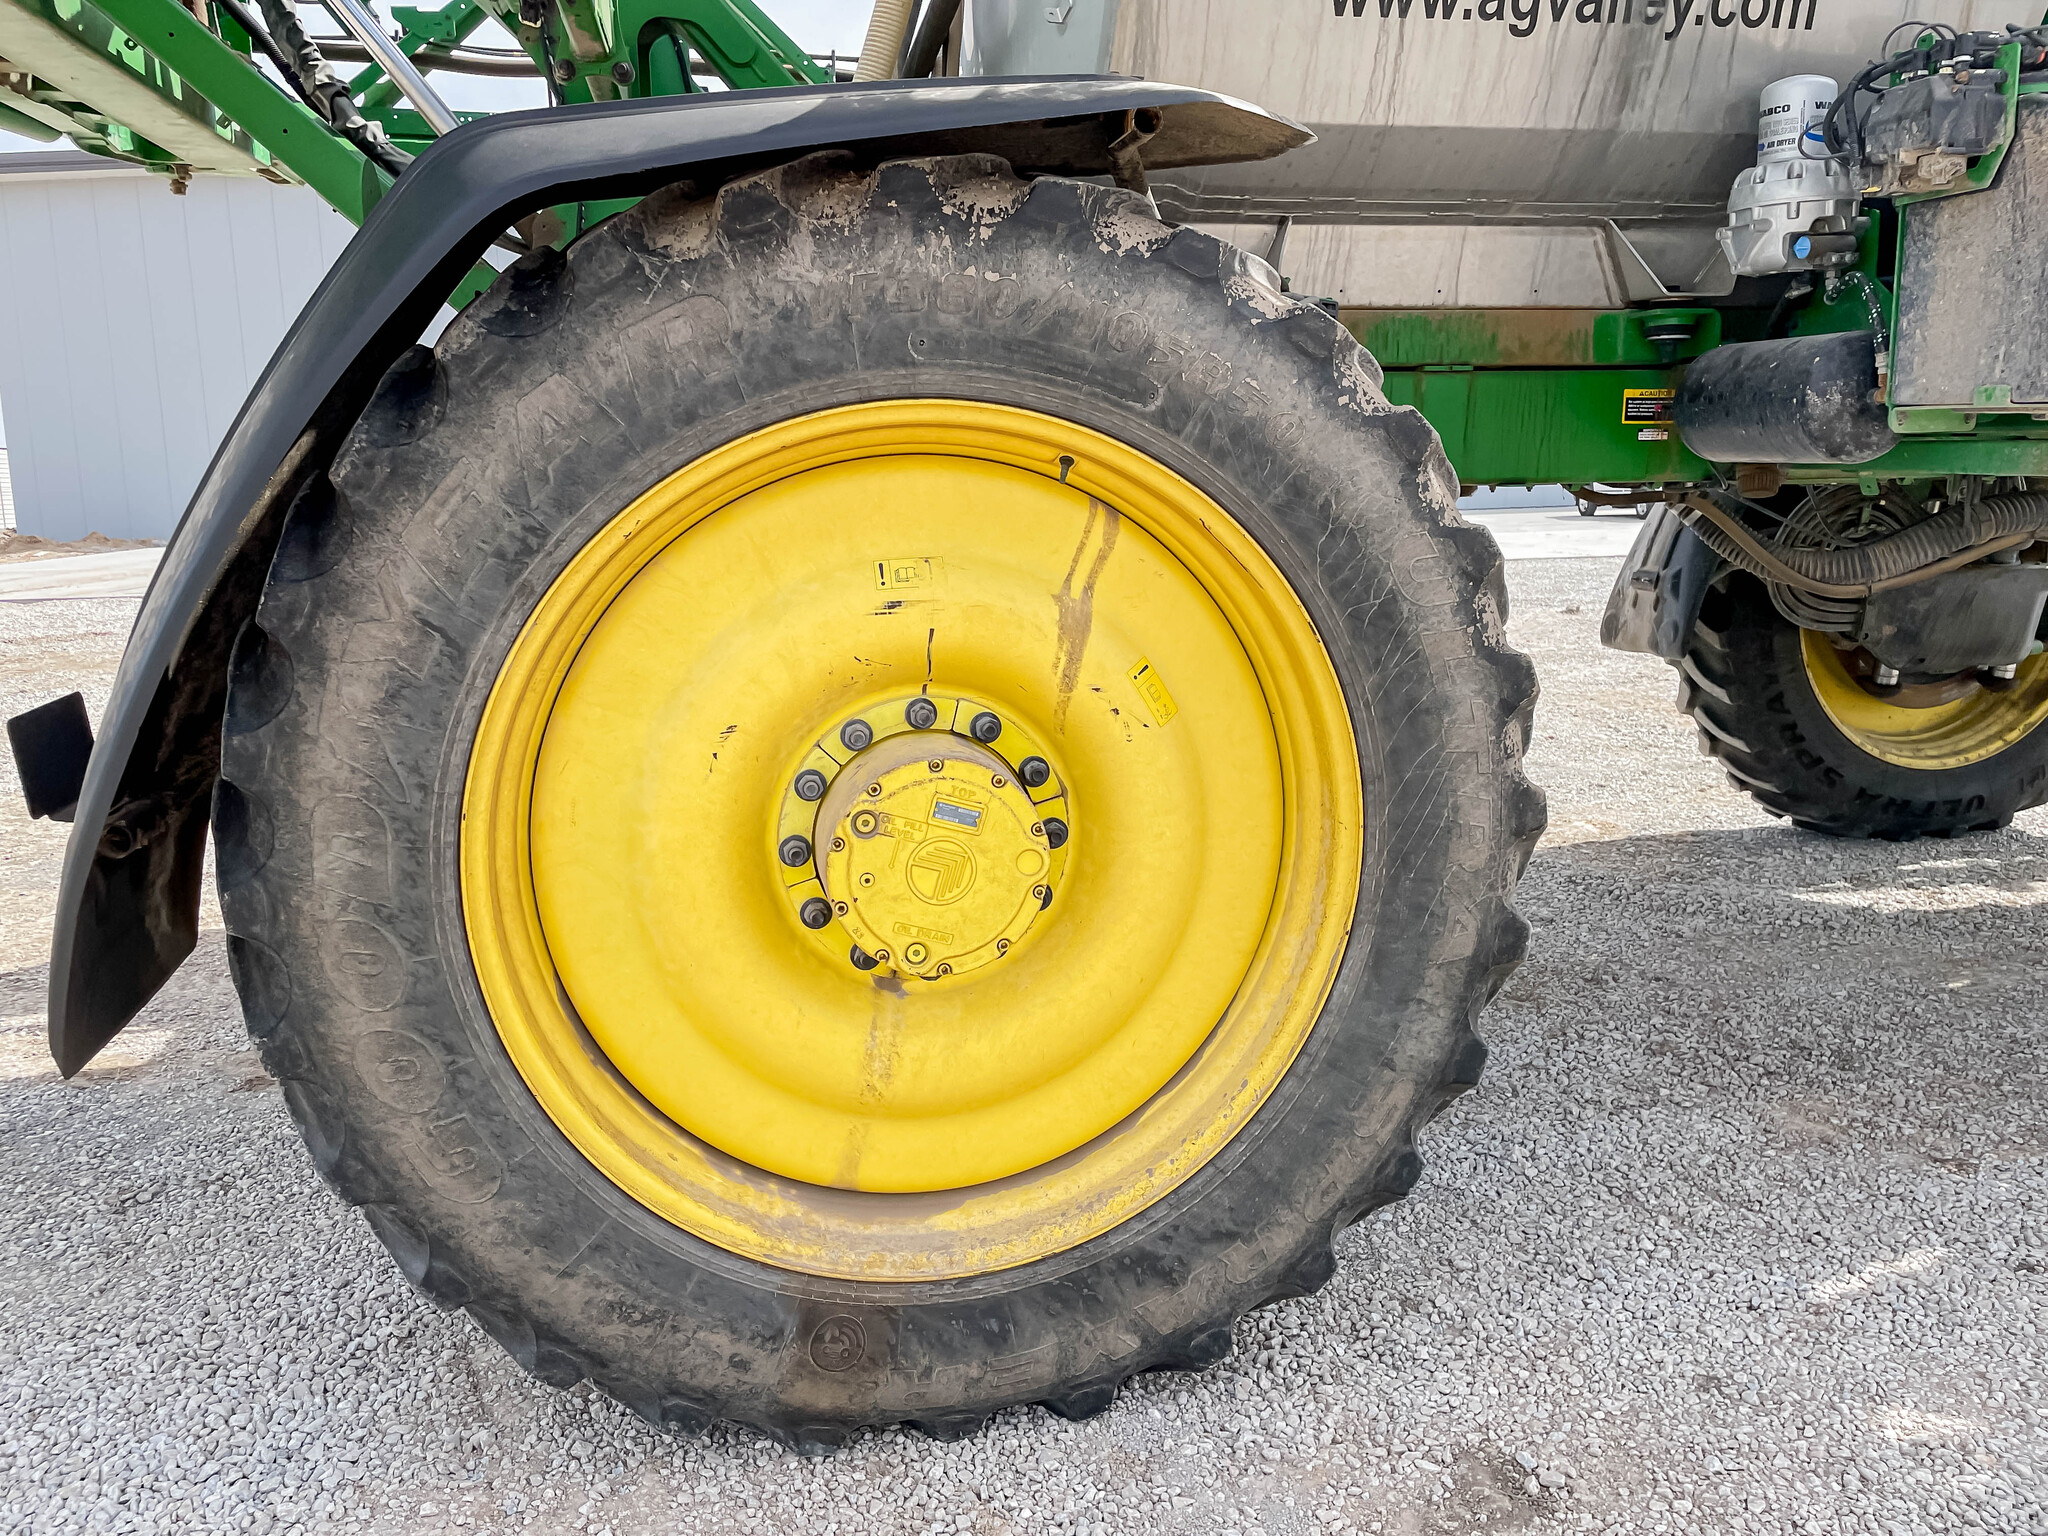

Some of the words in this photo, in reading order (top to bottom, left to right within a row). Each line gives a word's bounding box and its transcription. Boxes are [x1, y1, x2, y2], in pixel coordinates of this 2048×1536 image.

[1332, 0, 1818, 40] www.agvalley.com
[950, 784, 977, 799] TOP
[881, 814, 898, 826] OIL
[903, 820, 924, 833] FILL
[883, 826, 915, 840] LEVEL
[896, 924, 913, 935] OIL
[916, 927, 951, 944] DRAIN
